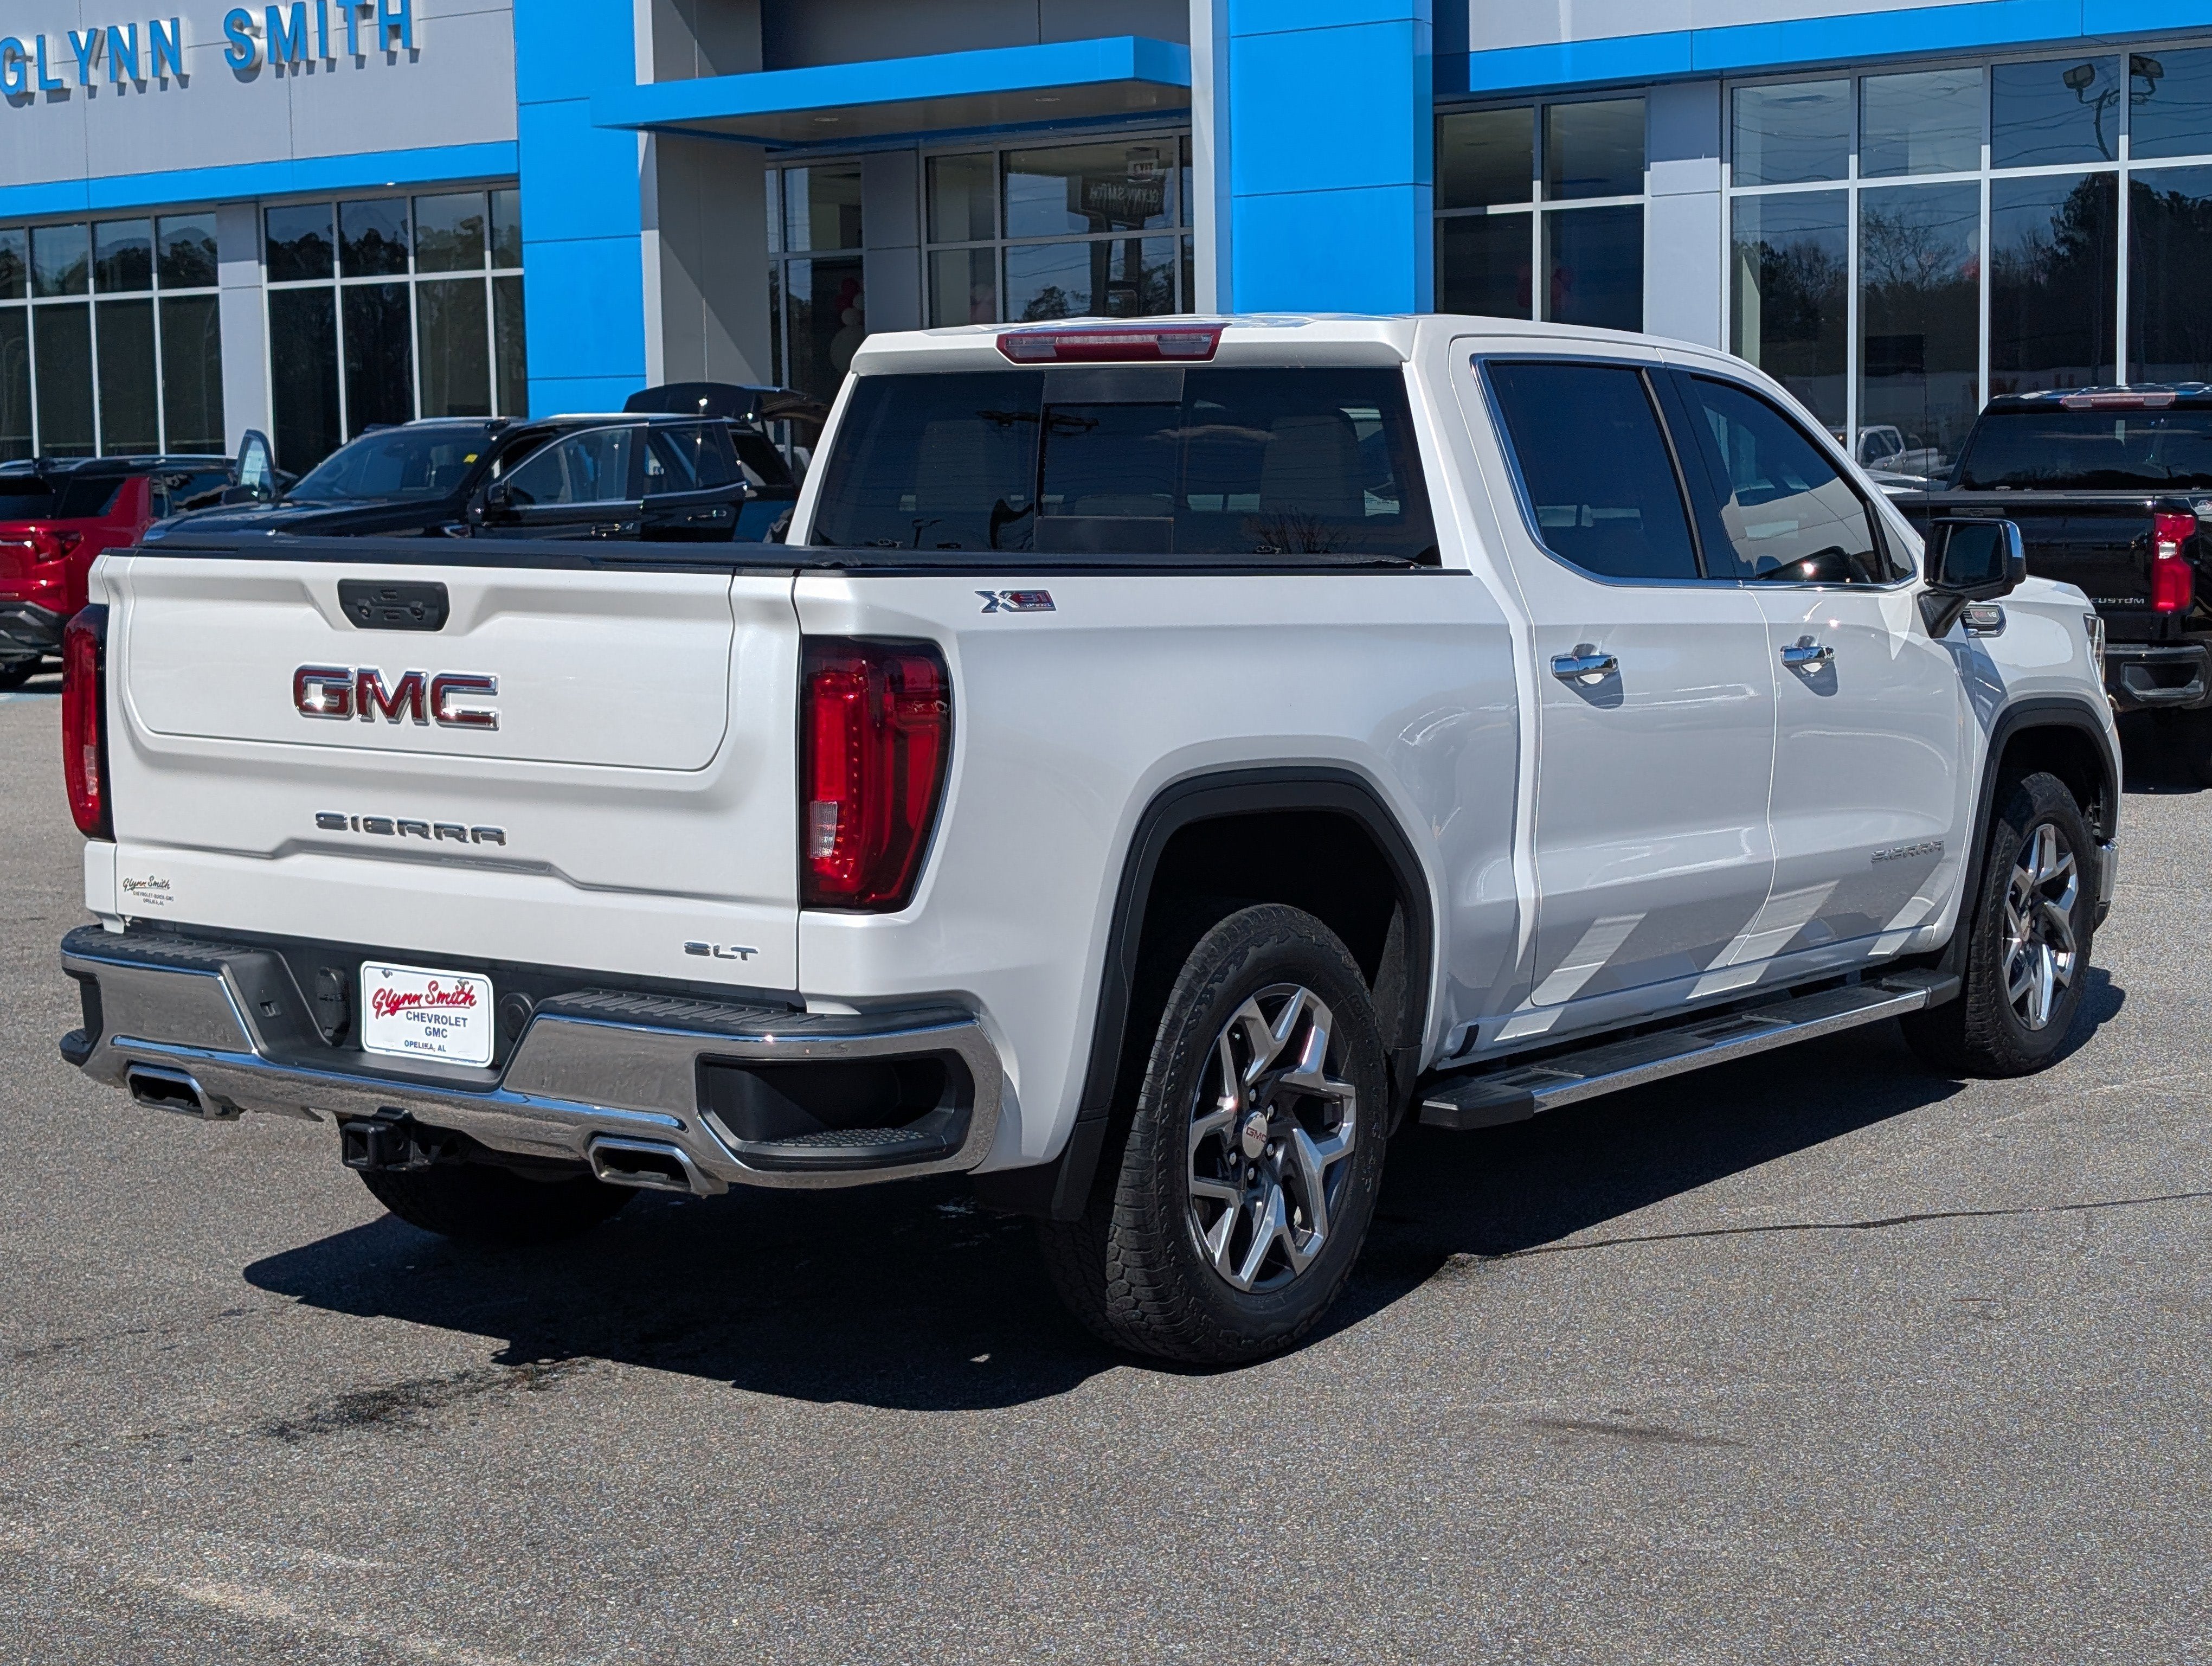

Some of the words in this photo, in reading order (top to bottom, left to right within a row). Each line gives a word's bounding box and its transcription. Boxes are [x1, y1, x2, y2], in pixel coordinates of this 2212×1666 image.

[0, 17, 183, 96] GLYNN
[223, 0, 412, 69] SMITH
[293, 663, 500, 731] GMC
[316, 811, 507, 846] SIERRA
[123, 877, 147, 893] Glynn
[147, 875, 171, 890] Smith
[684, 941, 759, 961] SLT
[372, 988, 423, 1020] Glynn
[425, 980, 477, 1008] Smith
[406, 1011, 468, 1028] CHEVROLET
[425, 1026, 448, 1039] GMC
[404, 1040, 436, 1052] OPELIKA,
[437, 1044, 446, 1052] AL
[1246, 1126, 1267, 1143] GMC
